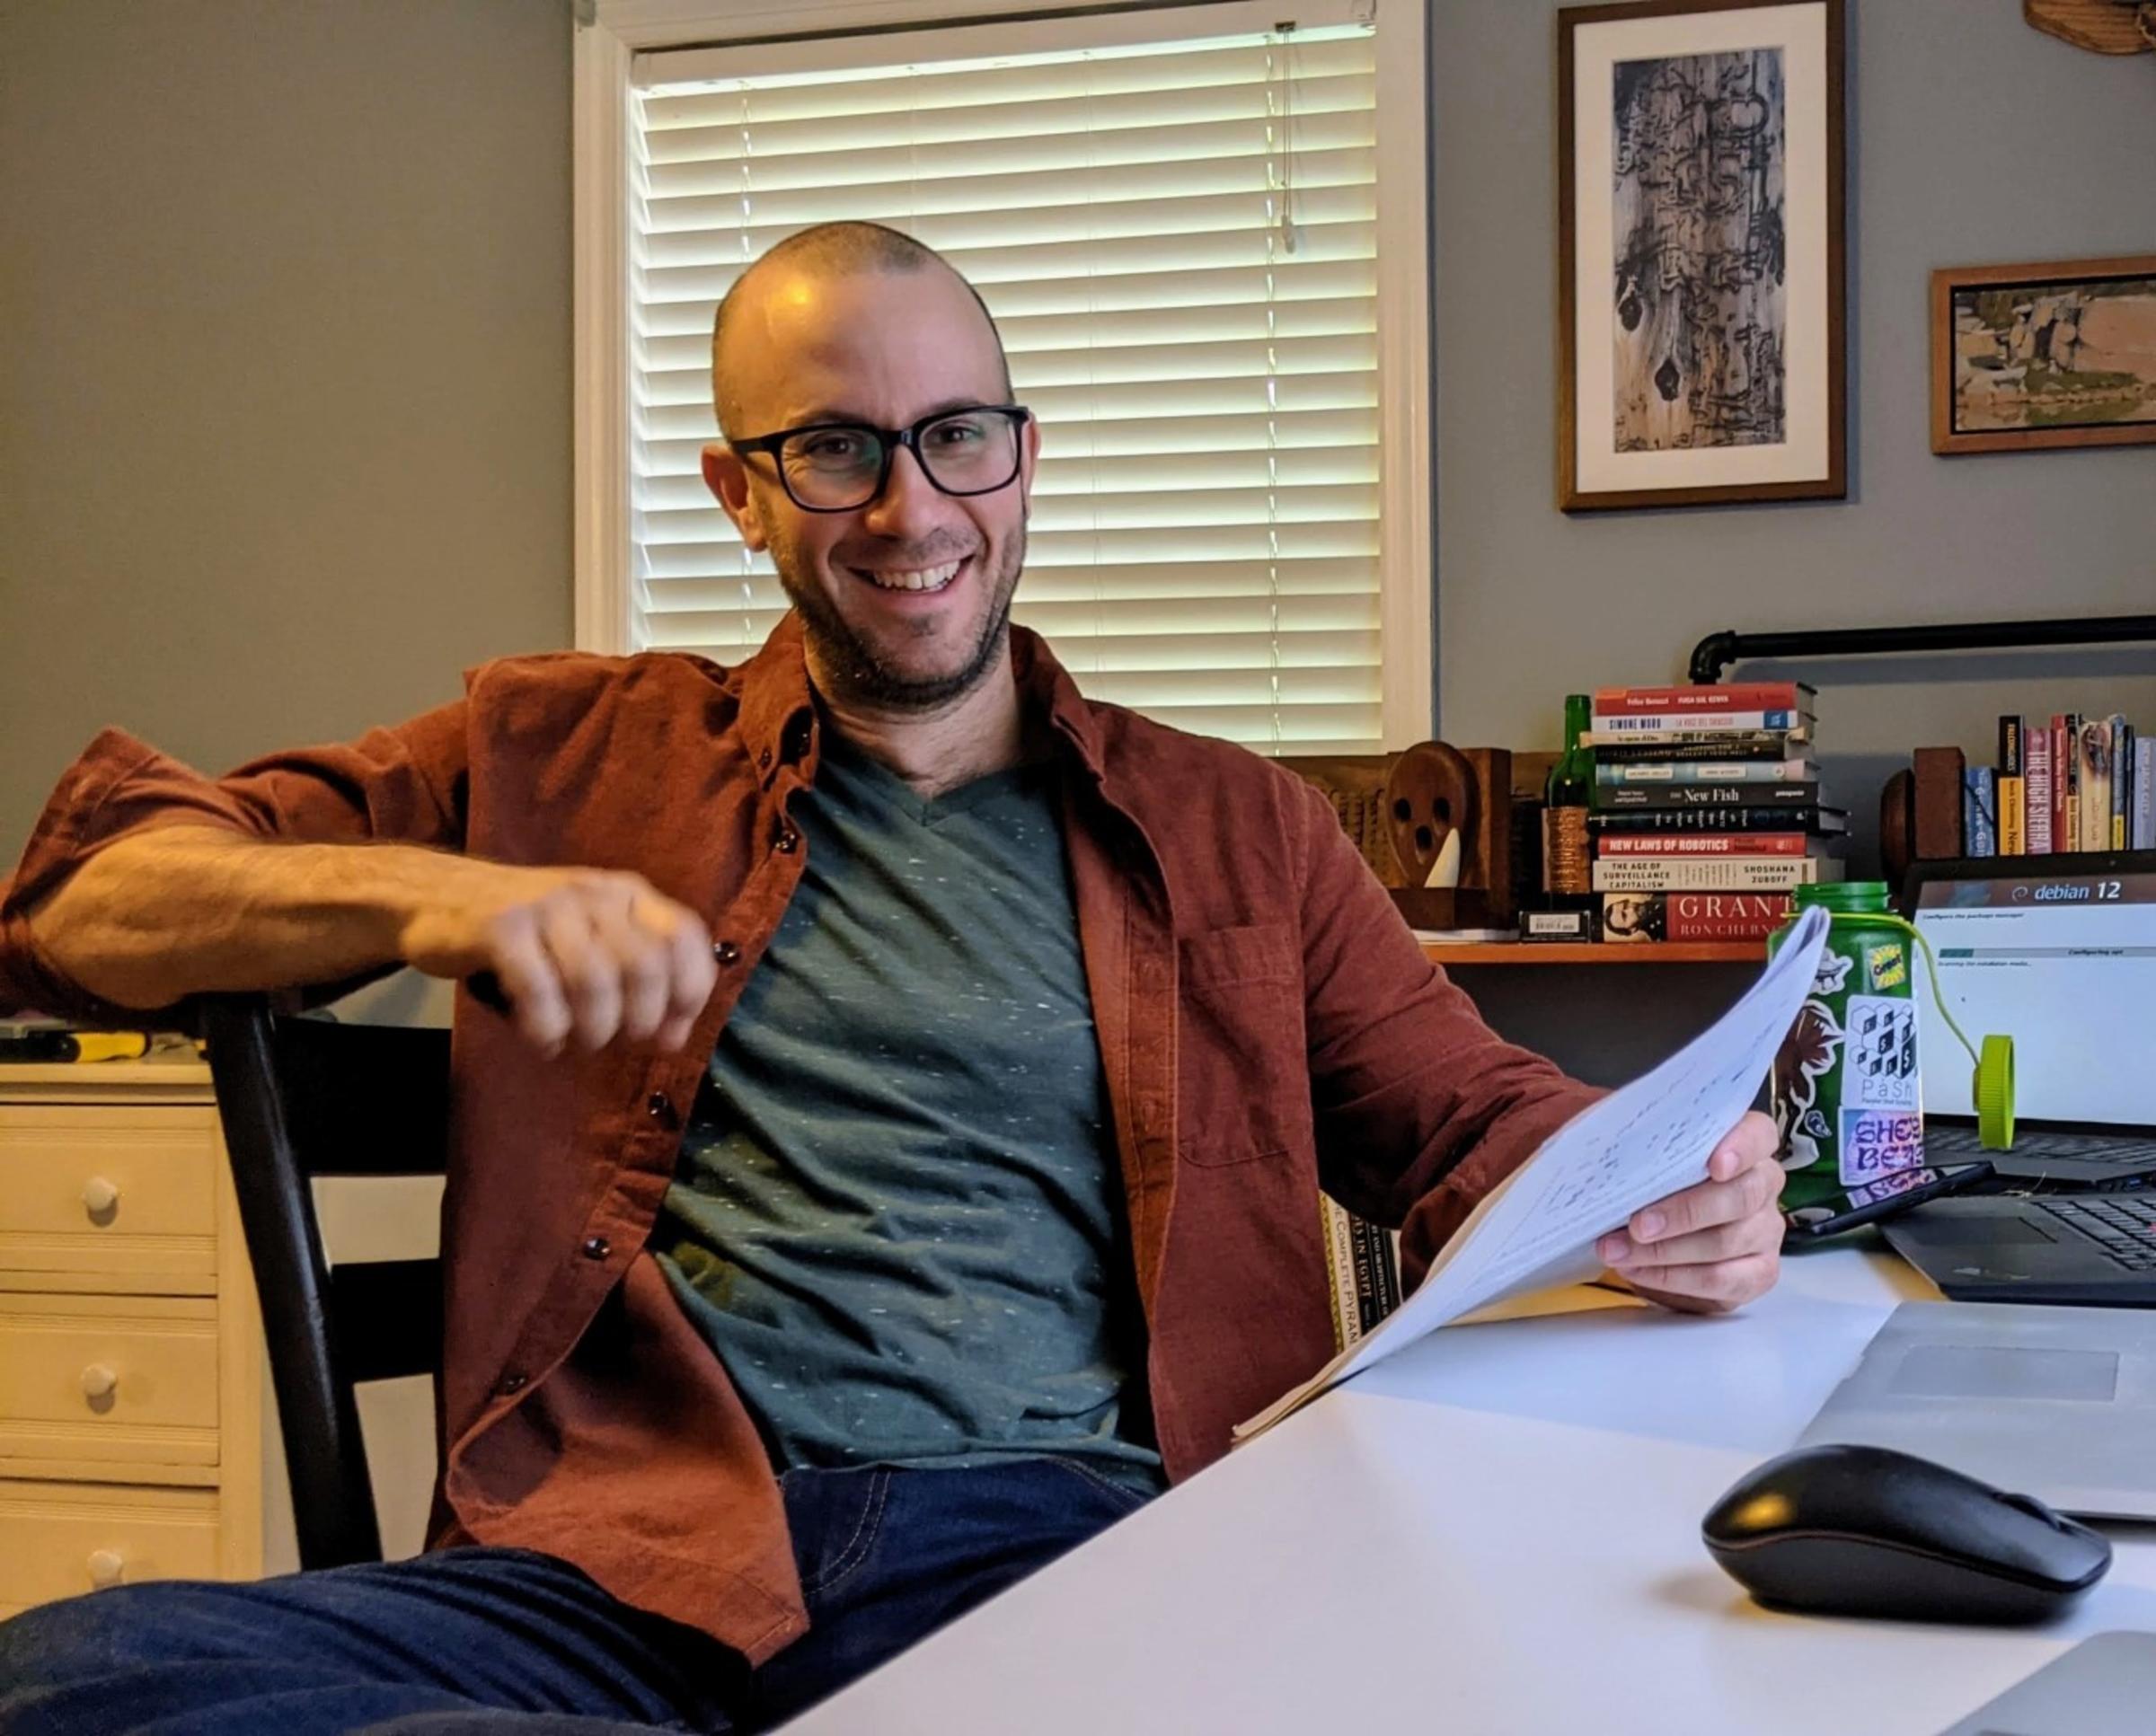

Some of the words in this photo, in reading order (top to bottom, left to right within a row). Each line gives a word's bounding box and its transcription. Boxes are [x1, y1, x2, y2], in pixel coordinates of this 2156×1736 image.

[1609, 718, 1638, 730] SIMONE
[2028, 749, 2048, 771] THE
[1684, 789, 1709, 803] New
[1712, 788, 1739, 802] Fish
[2028, 775, 2049, 804] HIGH
[2028, 806, 2049, 850] SIERRA
[1610, 840, 1633, 851] NEW
[1634, 840, 1662, 851] LAWS
[1663, 840, 1676, 851] OF
[1678, 839, 1728, 851] ROBOTICS
[1604, 872, 1671, 880] SURVEILLANCE
[1744, 866, 1796, 874] SHOSHANA
[1752, 876, 1788, 884] ZUBOFF
[2034, 884, 2090, 900] debian
[2097, 881, 2121, 899] 12
[1679, 896, 1791, 918] GRANT
[1681, 924, 1711, 936] RON
[1717, 923, 1776, 936] CHERN
[1336, 1220, 1349, 1288] COMPLETE
[1356, 1239, 1366, 1255] IN
[1356, 1259, 1373, 1298] EGYPT
